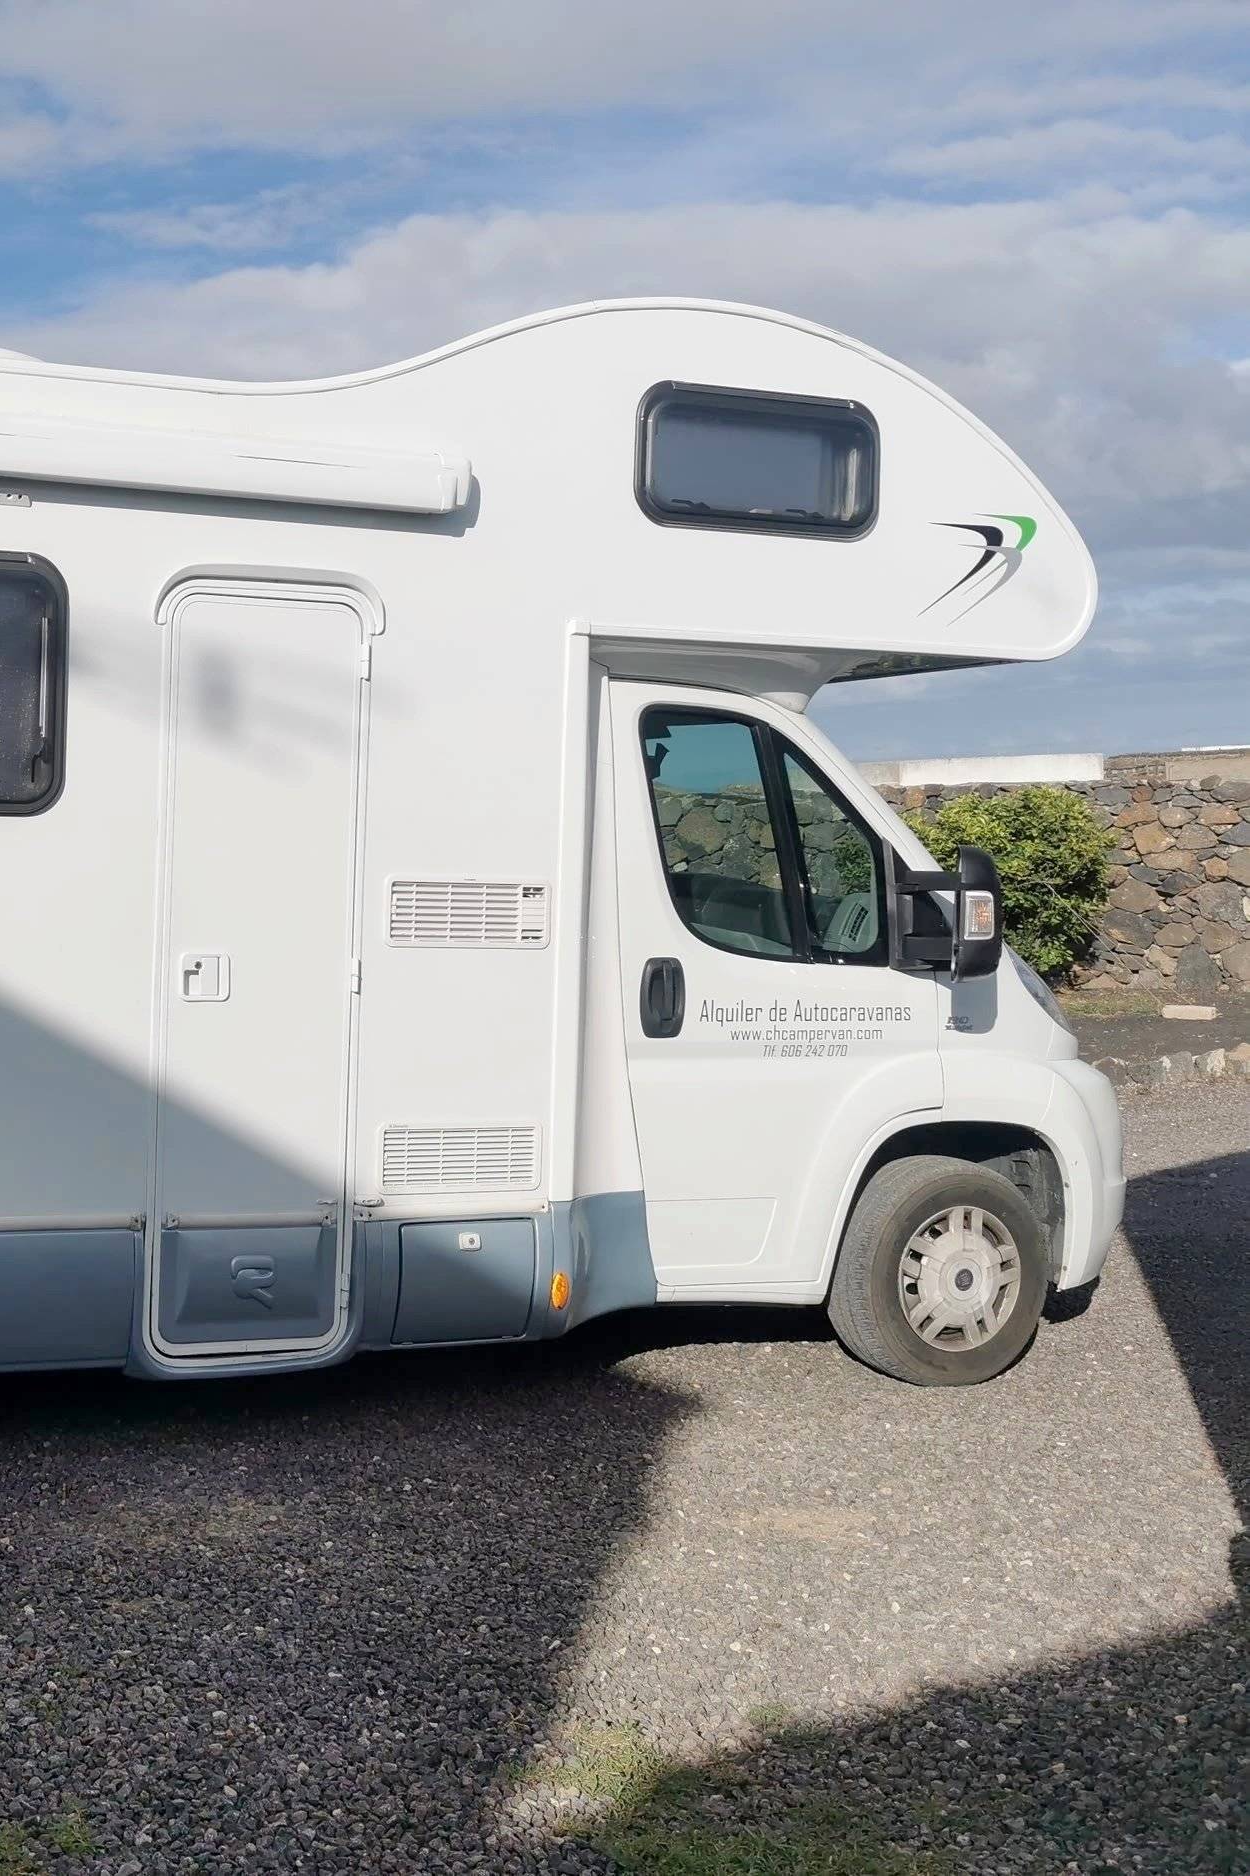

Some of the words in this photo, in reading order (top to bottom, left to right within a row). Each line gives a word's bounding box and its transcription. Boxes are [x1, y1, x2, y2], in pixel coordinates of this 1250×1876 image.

[699, 999, 763, 1027] Alquiler
[769, 999, 787, 1021] de
[793, 999, 911, 1022] Autocaravanas
[730, 1024, 883, 1043] www.chcampervan.com
[780, 1044, 803, 1057] 606
[805, 1044, 826, 1057] 242
[826, 1044, 848, 1057] 070
